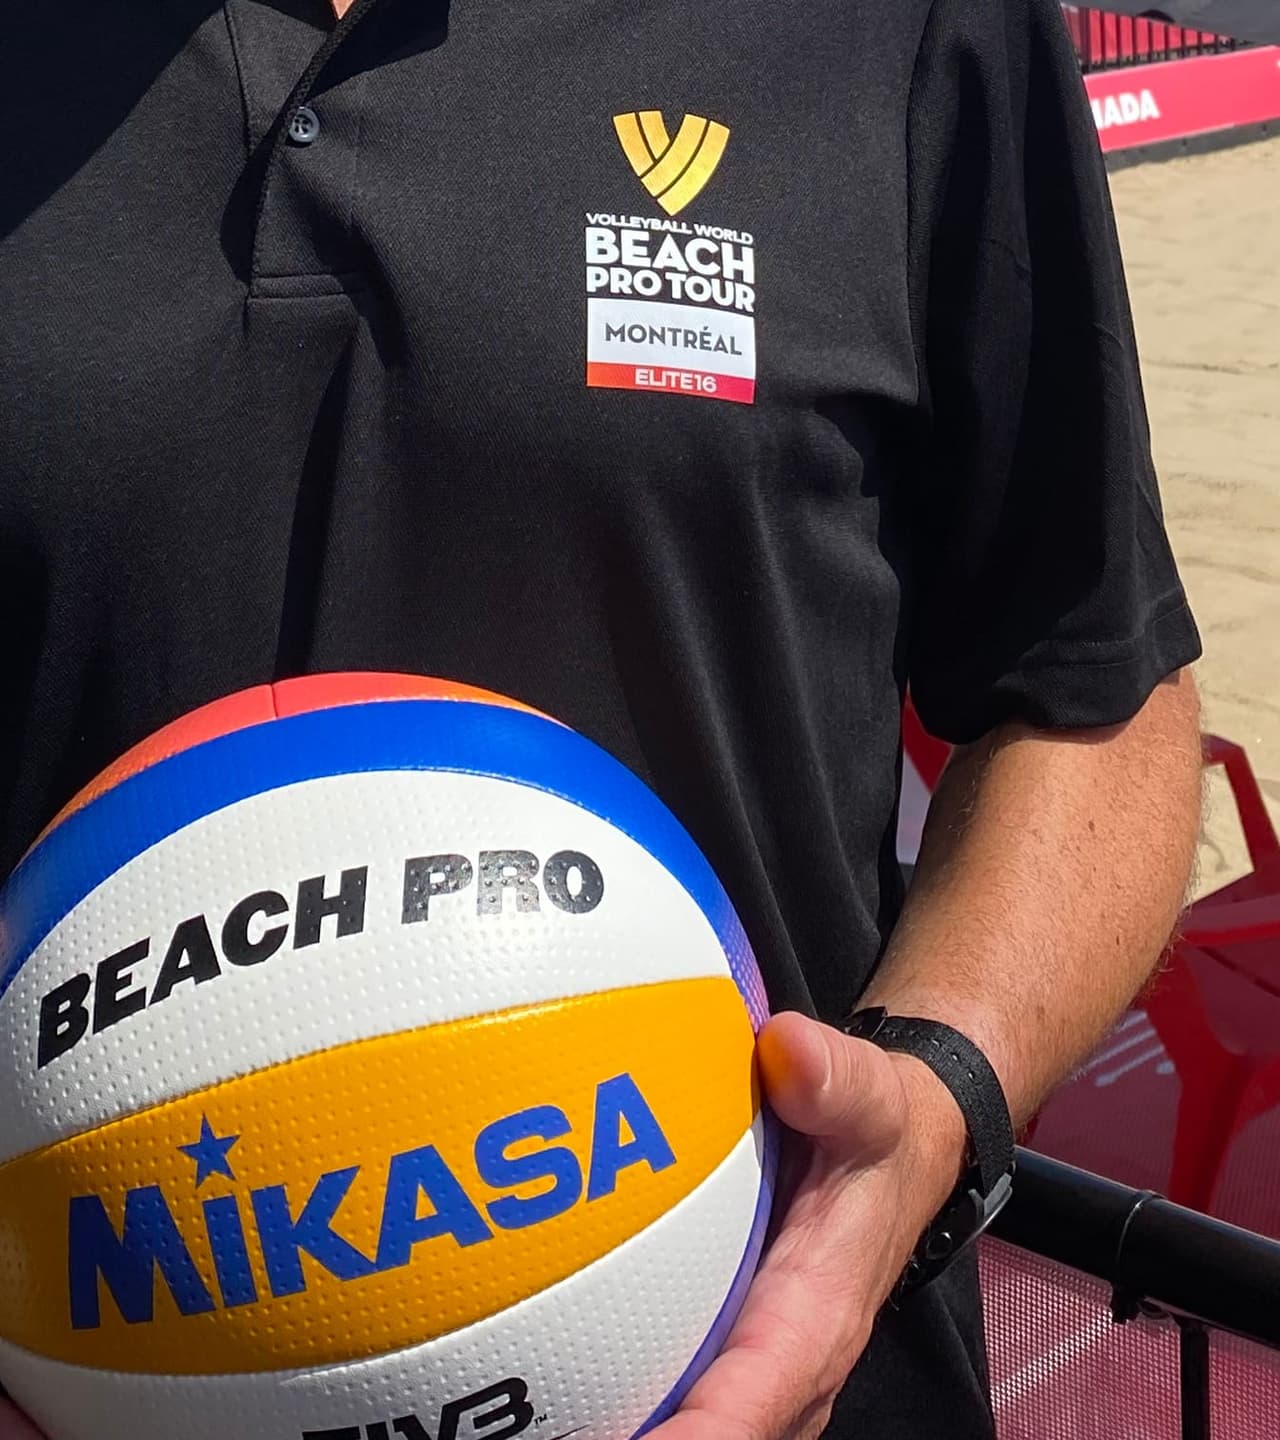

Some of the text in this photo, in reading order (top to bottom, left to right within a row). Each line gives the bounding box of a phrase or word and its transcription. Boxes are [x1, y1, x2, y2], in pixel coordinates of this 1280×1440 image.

[585, 213, 754, 245] VOLLEYBALL WORLD
[585, 227, 755, 285] BEACH
[586, 266, 756, 313] PRO TOUR
[605, 323, 743, 356] MONTRÉAL
[634, 367, 717, 394] ELITE16
[36, 849, 605, 1069] BEACH PRO
